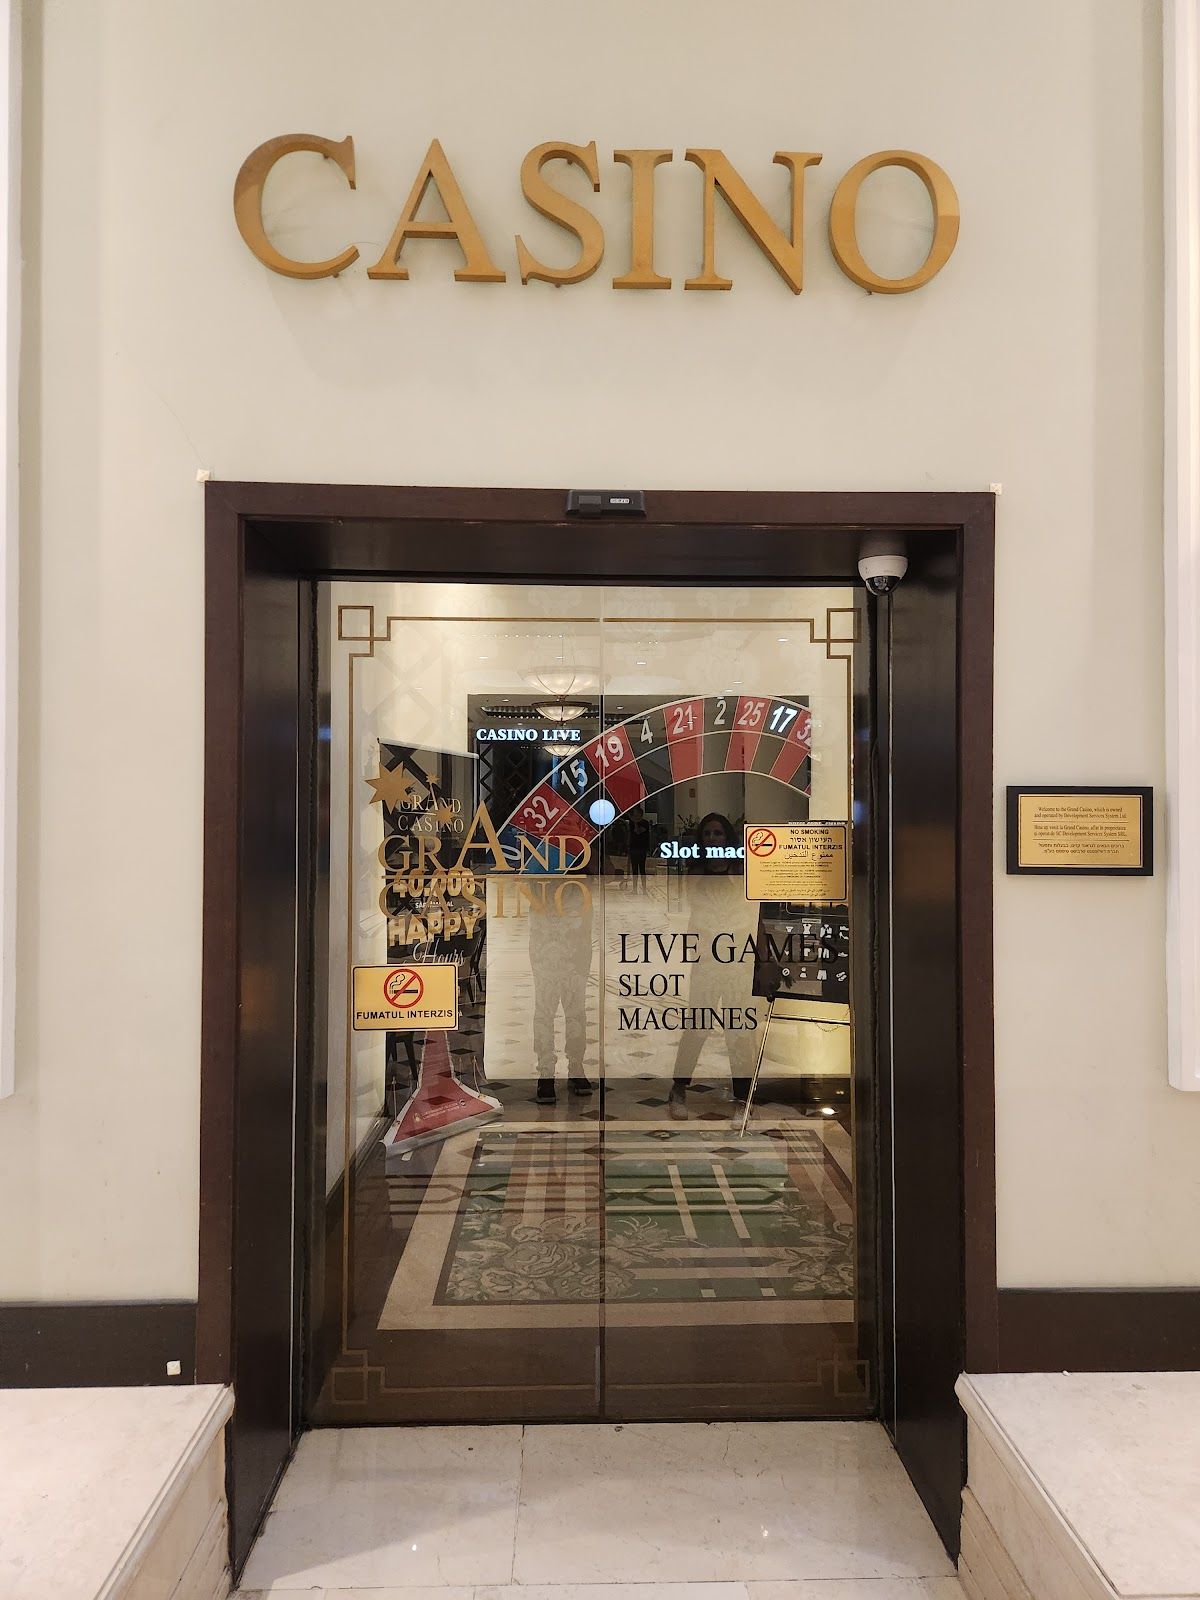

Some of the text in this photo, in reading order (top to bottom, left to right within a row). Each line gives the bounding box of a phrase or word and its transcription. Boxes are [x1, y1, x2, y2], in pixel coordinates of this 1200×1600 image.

[233, 133, 960, 295] CASINO
[672, 705, 695, 735] 21
[714, 700, 727, 726] 2
[737, 701, 765, 727] 25
[769, 704, 798, 733] 17
[476, 729, 581, 742] CASINO LIVE
[640, 719, 653, 745] 4
[595, 735, 624, 768] 19
[561, 760, 589, 796] 15
[401, 782, 461, 813] GRAND
[523, 796, 560, 827] 32
[378, 800, 592, 872] GRAND
[398, 815, 464, 834] CASINO
[660, 841, 700, 859] Slot
[378, 880, 593, 920] CASINO
[388, 911, 480, 947] HAPPY
[618, 933, 838, 964] LIVE GAMES
[619, 974, 685, 996] SLOT
[356, 1009, 453, 1020] FUMATUL INTERZIS
[618, 1007, 758, 1030] MACHINES
